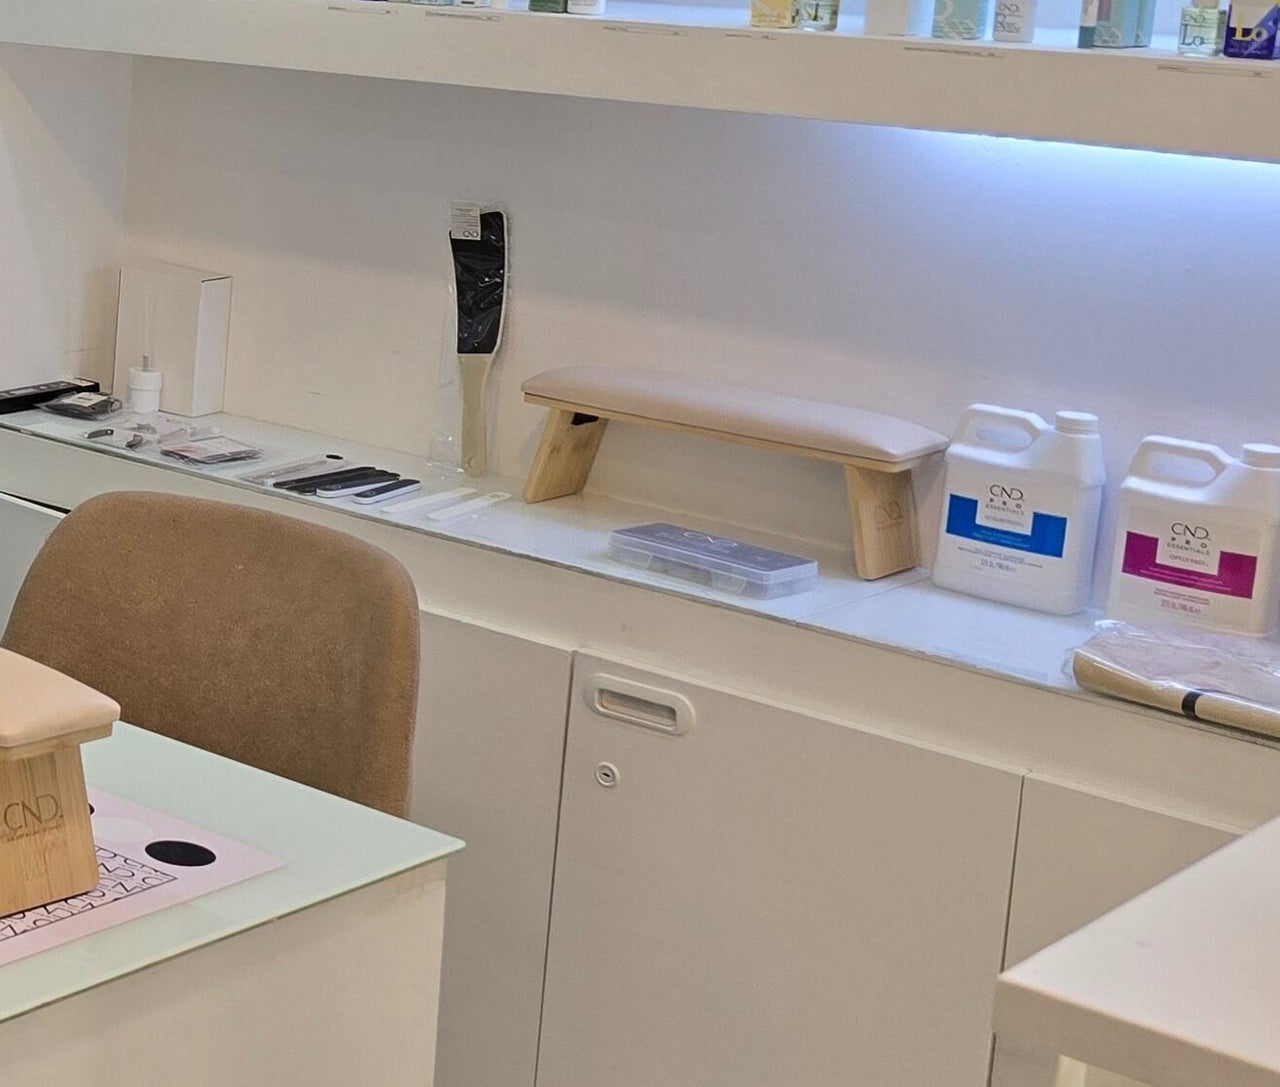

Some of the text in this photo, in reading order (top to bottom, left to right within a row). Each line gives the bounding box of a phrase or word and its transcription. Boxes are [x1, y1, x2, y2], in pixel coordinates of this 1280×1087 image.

[989, 483, 1025, 501] CND
[1171, 522, 1211, 541] CND
[1166, 542, 1211, 556] ESSENTIALS
[2, 792, 65, 831] CND
